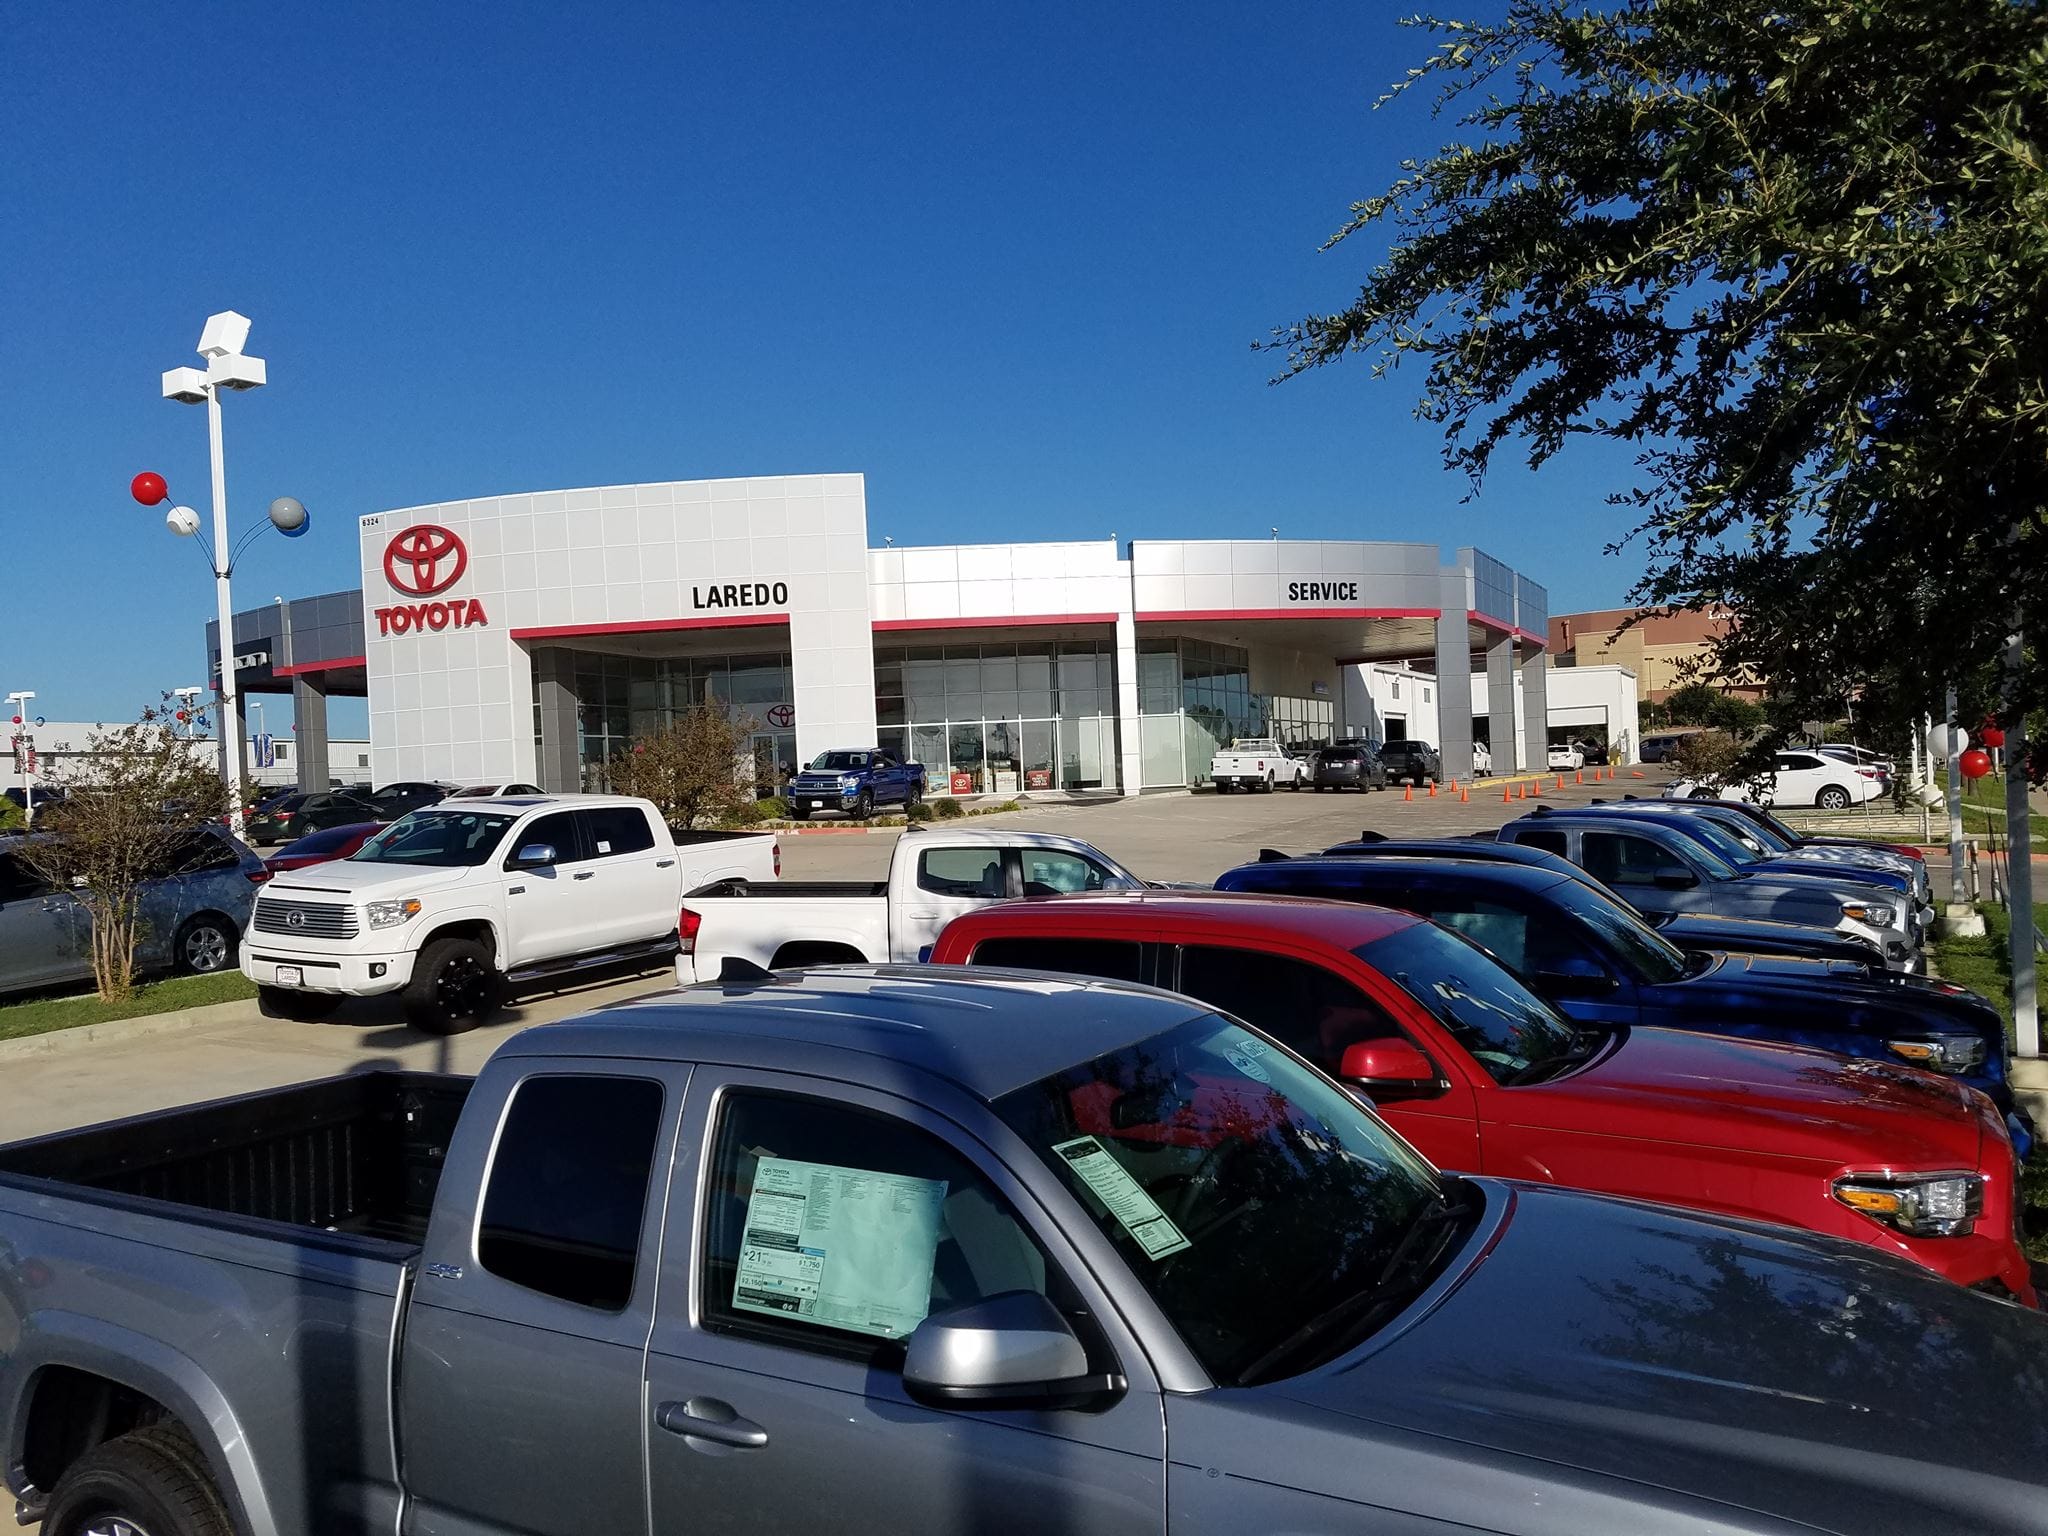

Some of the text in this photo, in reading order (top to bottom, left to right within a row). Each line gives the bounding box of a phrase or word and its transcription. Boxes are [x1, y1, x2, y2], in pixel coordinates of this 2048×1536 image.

[362, 517, 378, 526] 6324
[693, 582, 788, 609] LAREDO
[1288, 582, 1358, 601] SERVICE
[374, 598, 488, 637] TOYOTA
[748, 1250, 761, 1262] 21
